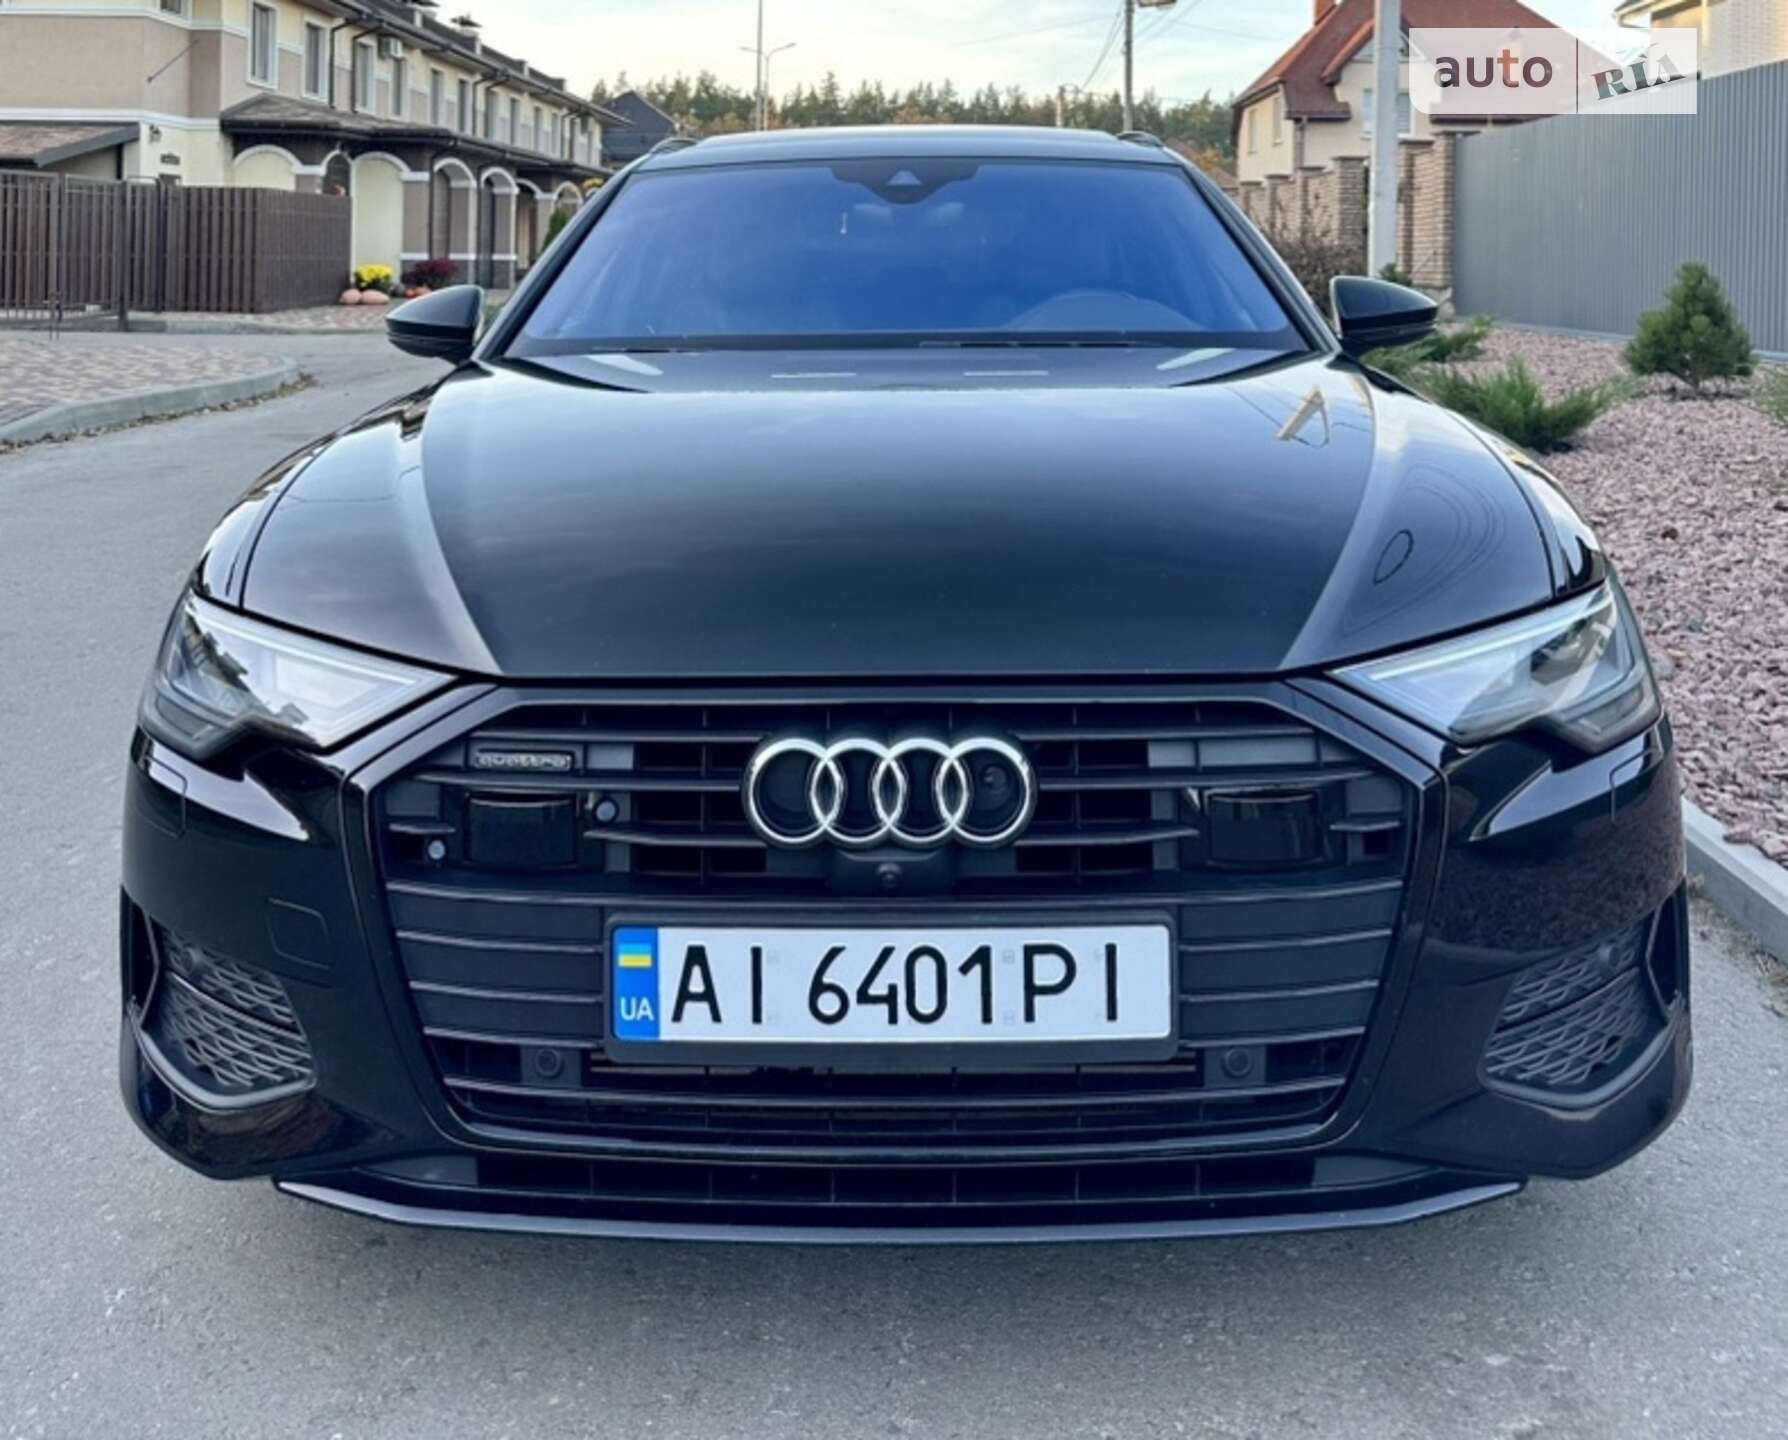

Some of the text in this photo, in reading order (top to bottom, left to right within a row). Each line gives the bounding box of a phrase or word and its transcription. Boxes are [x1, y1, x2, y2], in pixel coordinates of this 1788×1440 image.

[620, 997, 654, 1021] UA
[672, 943, 1118, 1025] AI 6401 PI
